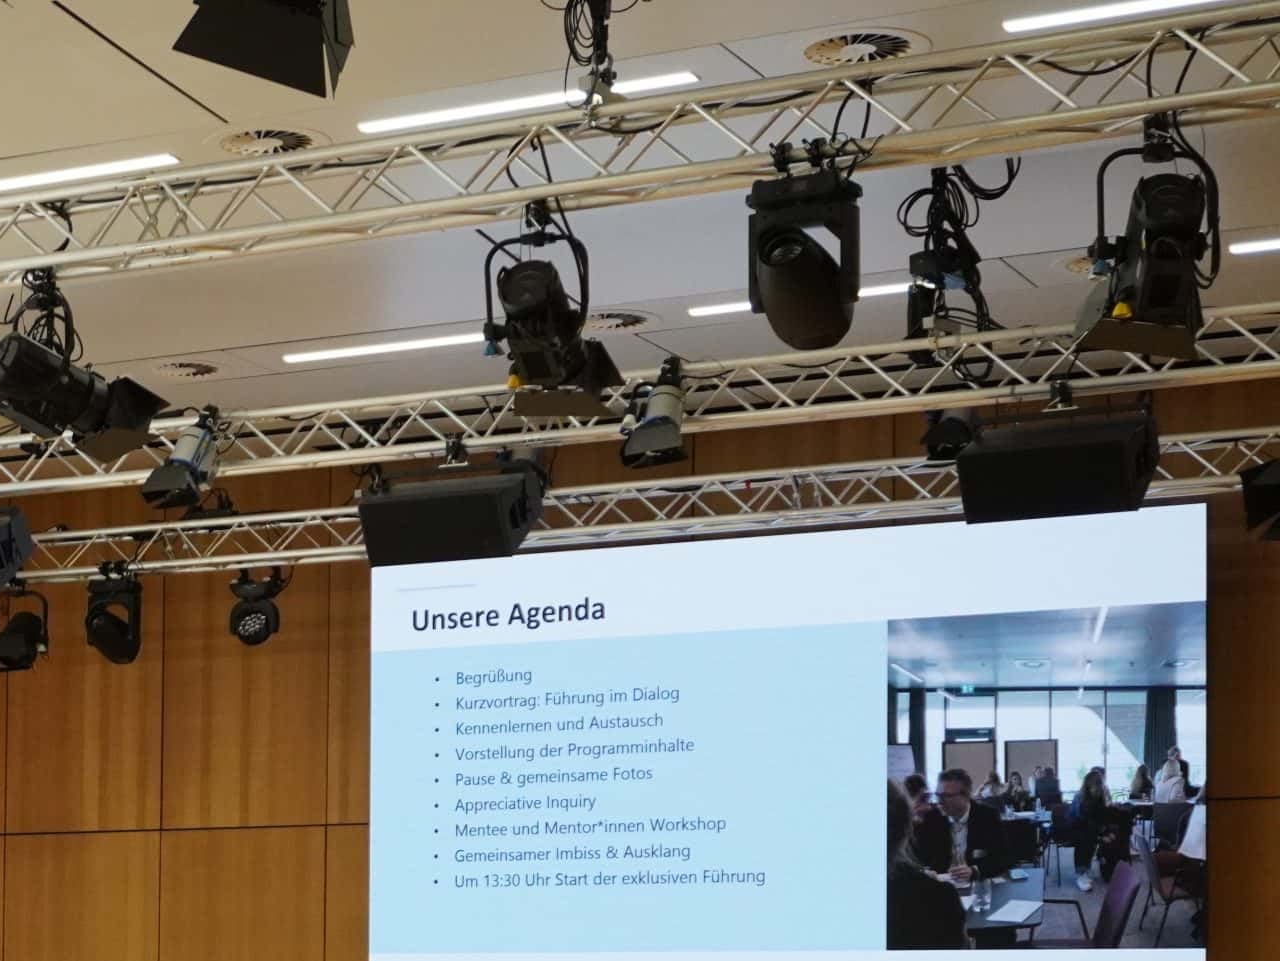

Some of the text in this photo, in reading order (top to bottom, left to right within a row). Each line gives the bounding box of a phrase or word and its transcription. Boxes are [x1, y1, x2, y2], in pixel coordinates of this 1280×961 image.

[411, 595, 606, 633] Unsere Agenda
[456, 668, 533, 688] Begrüßung
[455, 685, 680, 711] Kurzvortrag: Führung im Dialog
[455, 711, 664, 737] Kennenlernen und Austausch
[455, 737, 695, 763] Vorstellung der Programminhalte
[455, 766, 654, 789] Pause & gemeinsame Fotos
[454, 793, 597, 816] Appreciative Inquiry
[455, 823, 509, 838] Mentee
[512, 820, 540, 836] und
[649, 815, 727, 834] Workshop
[453, 843, 691, 863] Gemeinsamer Imbiss & Ausklang
[454, 868, 766, 889] Um 13:30 Uhr Start der exklusiven Führung
